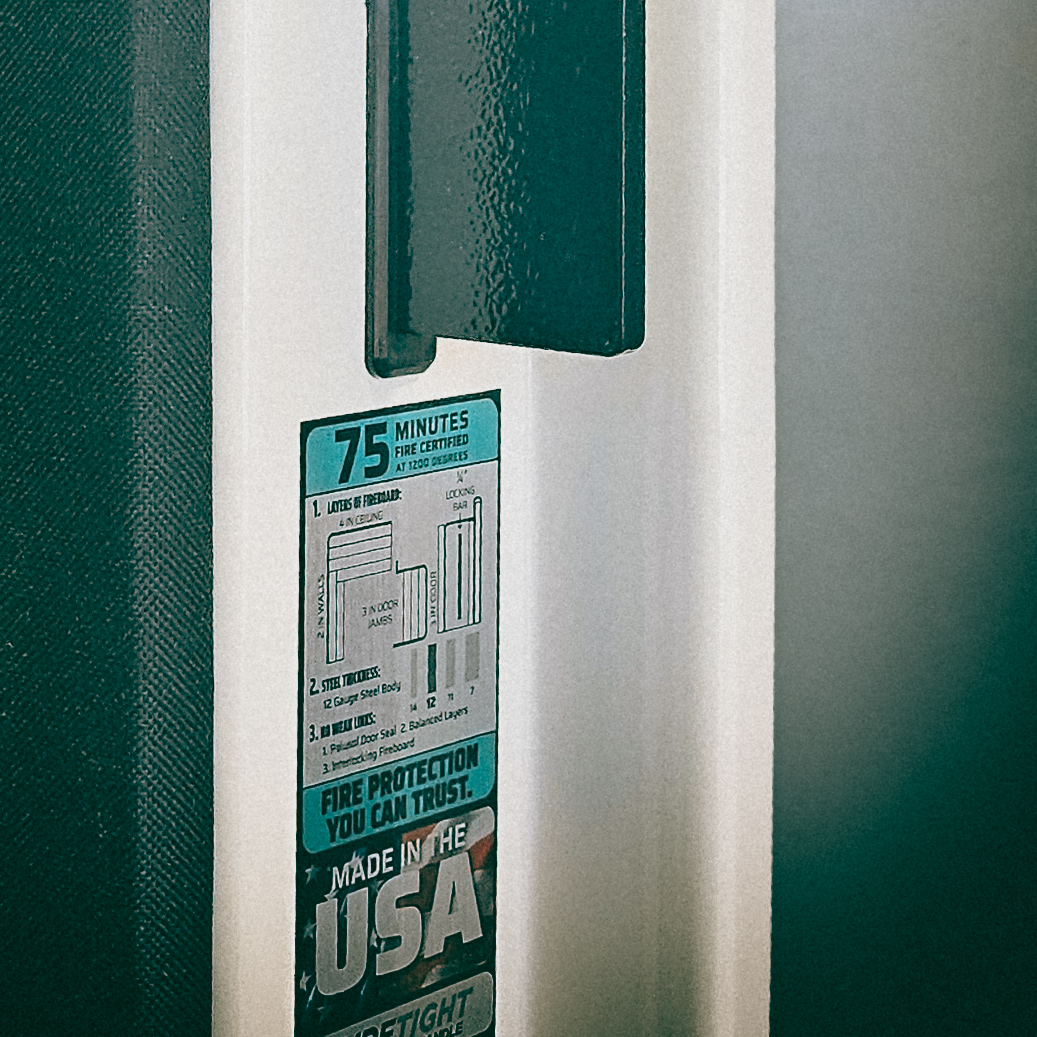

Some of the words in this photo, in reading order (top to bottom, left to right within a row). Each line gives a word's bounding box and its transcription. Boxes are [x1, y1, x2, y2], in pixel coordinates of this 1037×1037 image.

[395, 410, 469, 441] MINUTES
[335, 421, 390, 484] 75
[395, 443, 417, 458] FIRE
[420, 434, 469, 453] CERTIFIED
[395, 462, 406, 472] AT
[409, 458, 429, 470] 1200
[432, 450, 468, 466] DEGREES
[445, 485, 475, 500] LOCKING
[312, 499, 321, 518] 1.
[327, 498, 352, 514] LAYERS
[453, 500, 467, 511] BAR
[355, 510, 383, 525] CEILING
[317, 574, 325, 615] WALLS
[378, 599, 399, 613] DOOR
[309, 678, 319, 696] 2.
[322, 677, 341, 693] STEEL
[323, 699, 332, 709] 12
[334, 693, 358, 707] Gauge
[360, 685, 380, 700] Steel
[381, 681, 402, 695] Body
[426, 696, 436, 709] 12
[309, 724, 319, 742] 3.
[361, 733, 379, 745] Door
[380, 724, 397, 740] Seal
[409, 711, 442, 731] Balanced
[444, 706, 468, 720] Layers
[379, 737, 415, 756] Fireboard
[322, 779, 363, 815] FIRE
[368, 743, 479, 801] PROTECTION
[326, 808, 365, 843] YOU
[371, 794, 407, 829] CAN
[411, 775, 473, 815] TRUST.
[330, 848, 394, 889] MADE
[401, 838, 421, 868] IN
[429, 823, 466, 857] THE
[316, 852, 483, 996] USA
